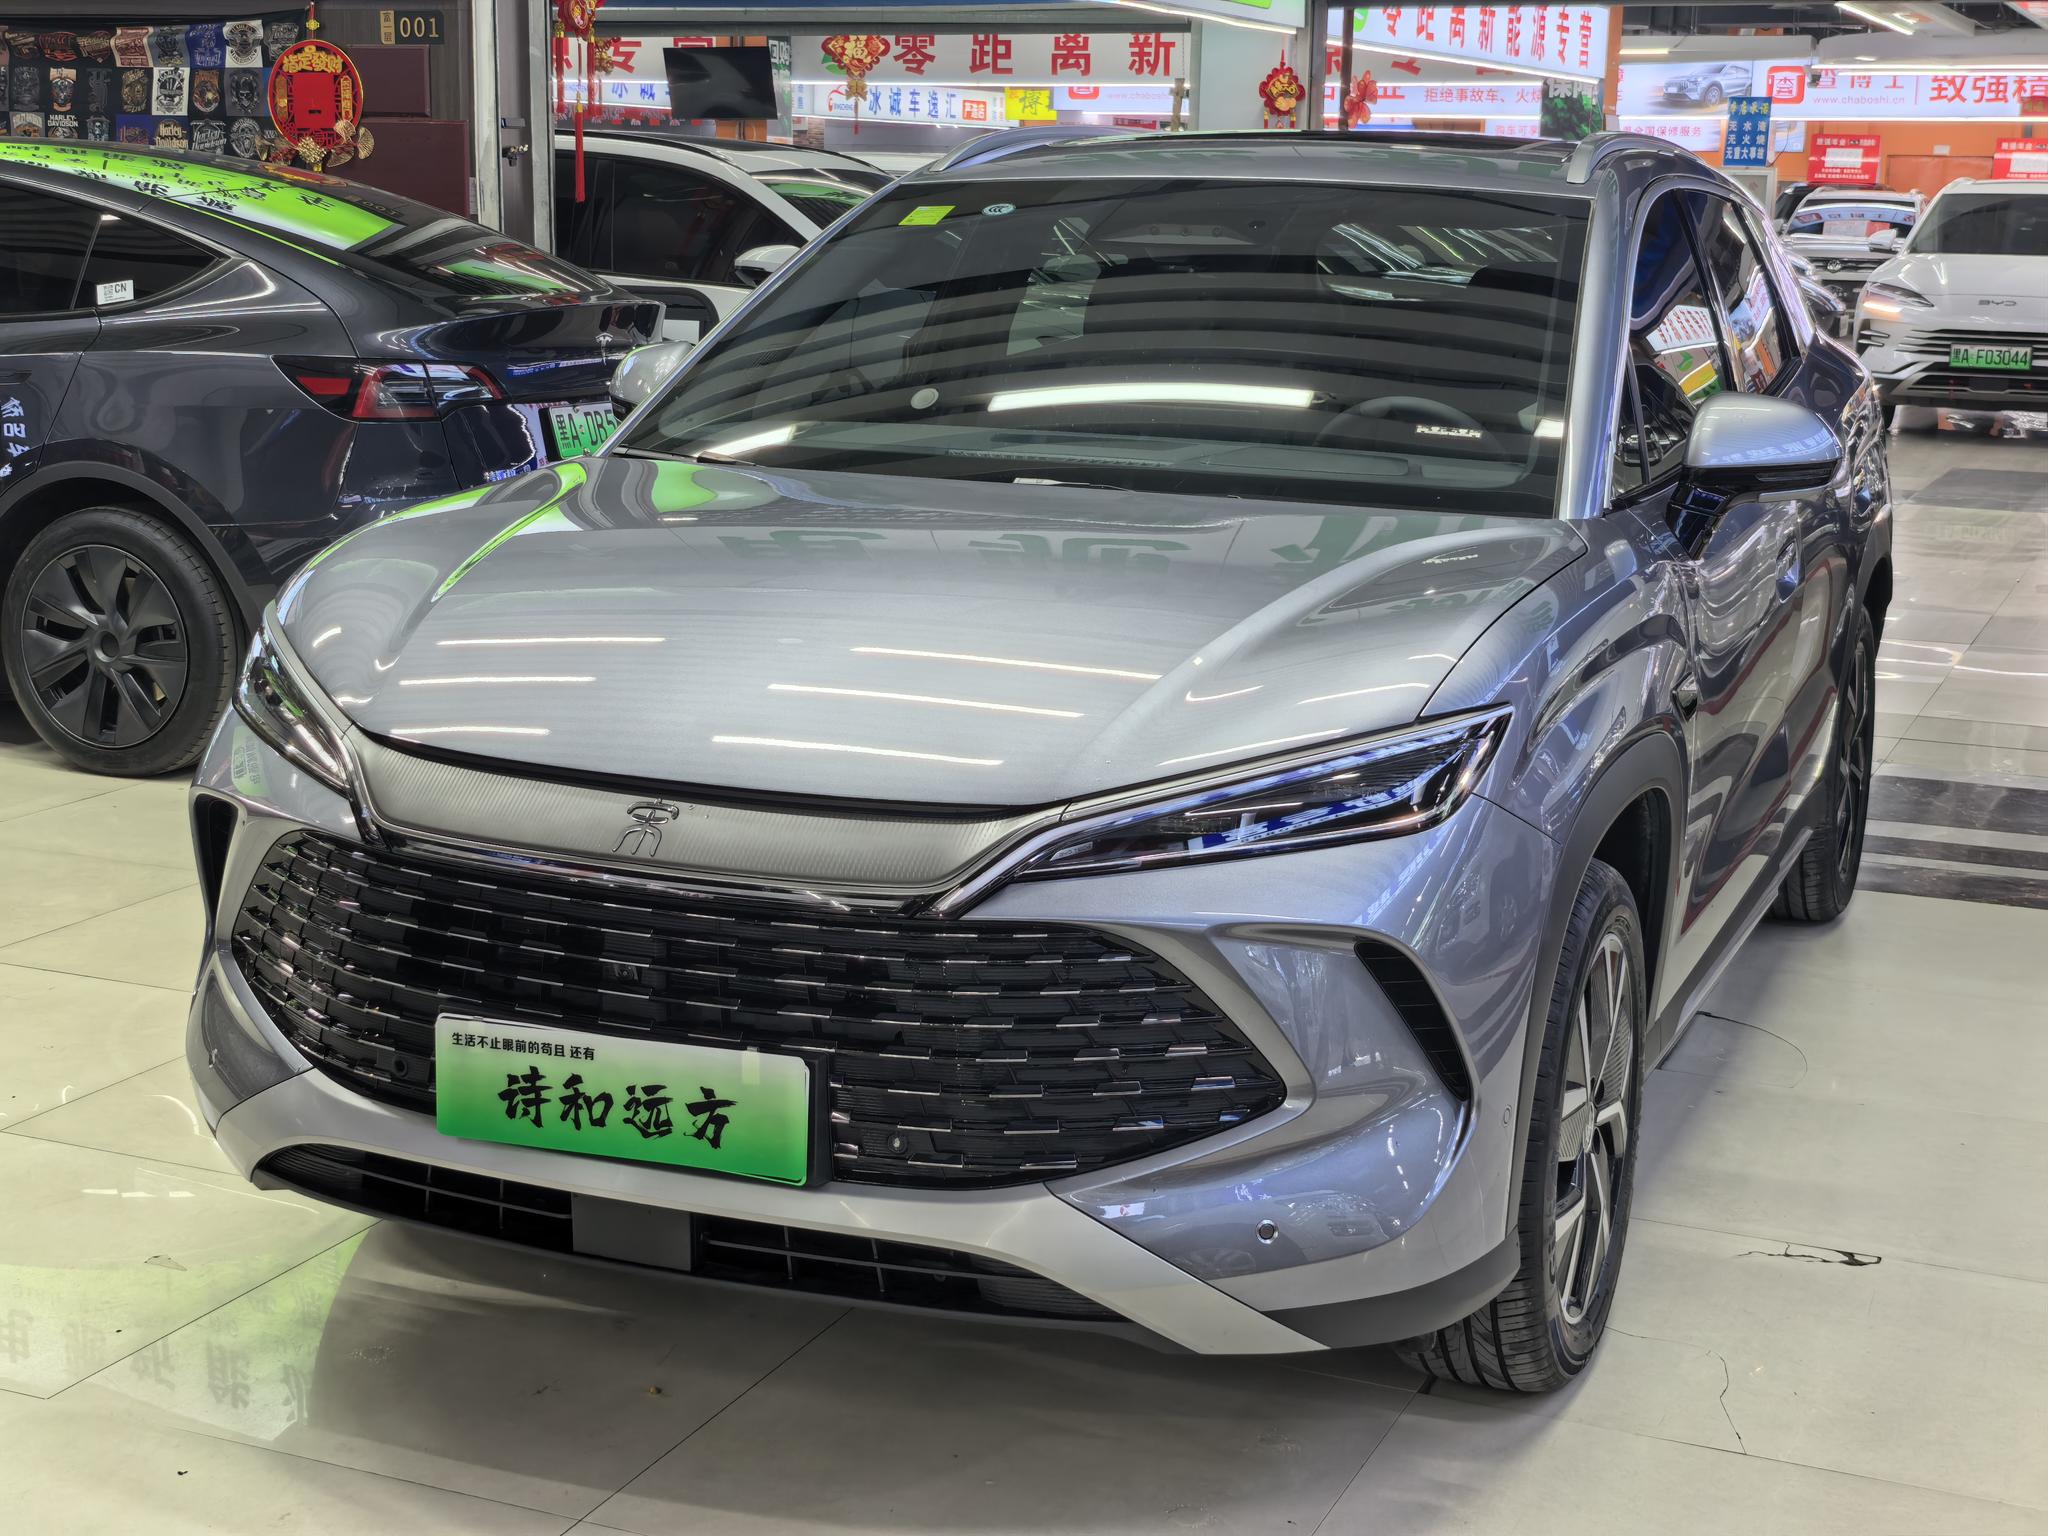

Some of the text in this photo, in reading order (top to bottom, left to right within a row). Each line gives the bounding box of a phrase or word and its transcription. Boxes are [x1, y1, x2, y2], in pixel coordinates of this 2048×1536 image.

[399, 16, 439, 38] 001
[893, 33, 1177, 76] 零距离新
[1813, 95, 1905, 104] www.chaboshi.cn
[47, 119, 79, 127] DAVIDSON
[1725, 146, 1765, 160] 无重大事故
[114, 282, 127, 293] CN
[1975, 349, 2029, 366] F03044
[451, 1031, 596, 1062] 生活不止眼前的苟且 还有
[497, 1066, 740, 1150] 诗和远方
